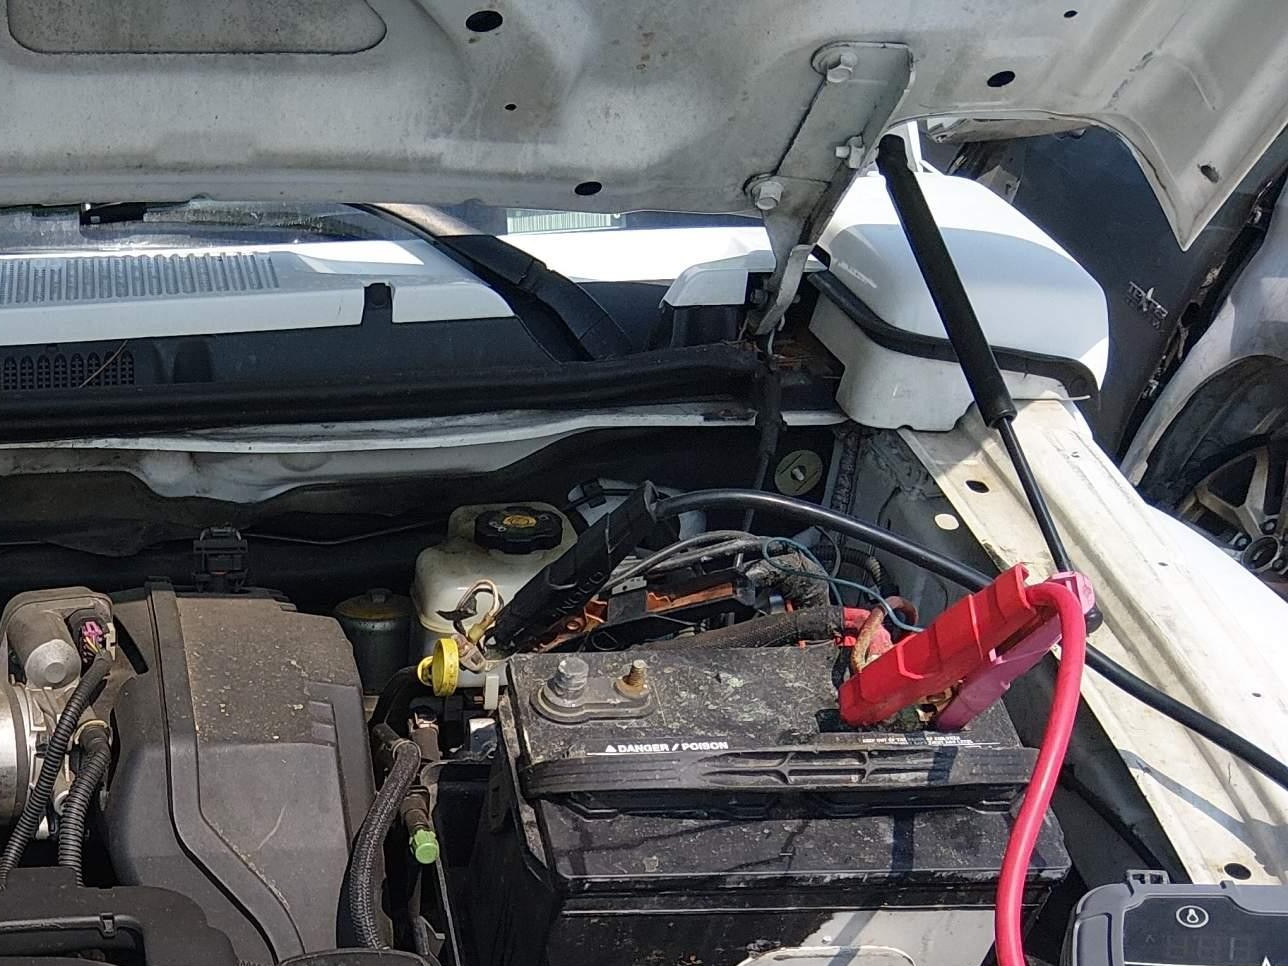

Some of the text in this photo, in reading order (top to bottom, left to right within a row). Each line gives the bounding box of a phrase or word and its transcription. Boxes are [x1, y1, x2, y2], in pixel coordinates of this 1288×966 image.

[618, 742, 729, 752] DANGER / POISON
